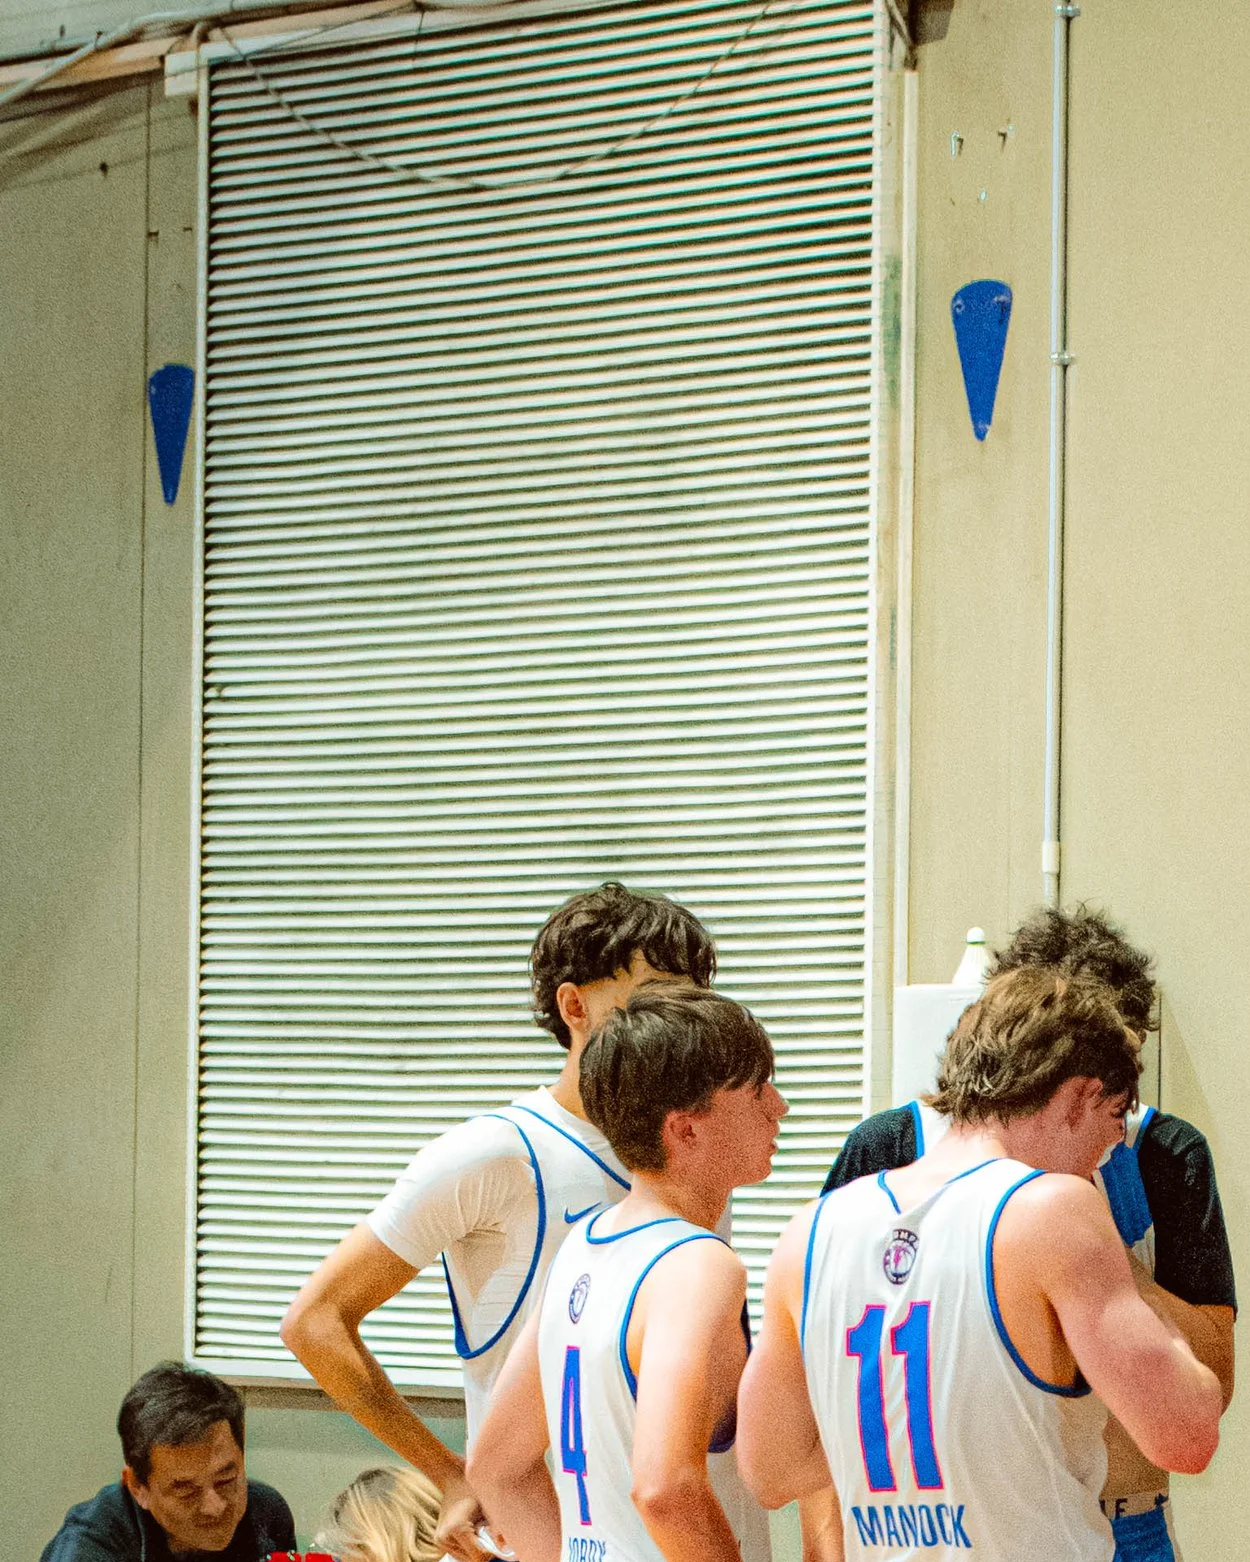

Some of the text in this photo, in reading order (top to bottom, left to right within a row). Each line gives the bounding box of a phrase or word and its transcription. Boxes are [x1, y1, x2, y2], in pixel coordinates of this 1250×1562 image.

[560, 1345, 592, 1526] 4
[846, 1301, 944, 1493] 11
[852, 1503, 972, 1548] MANOCK
